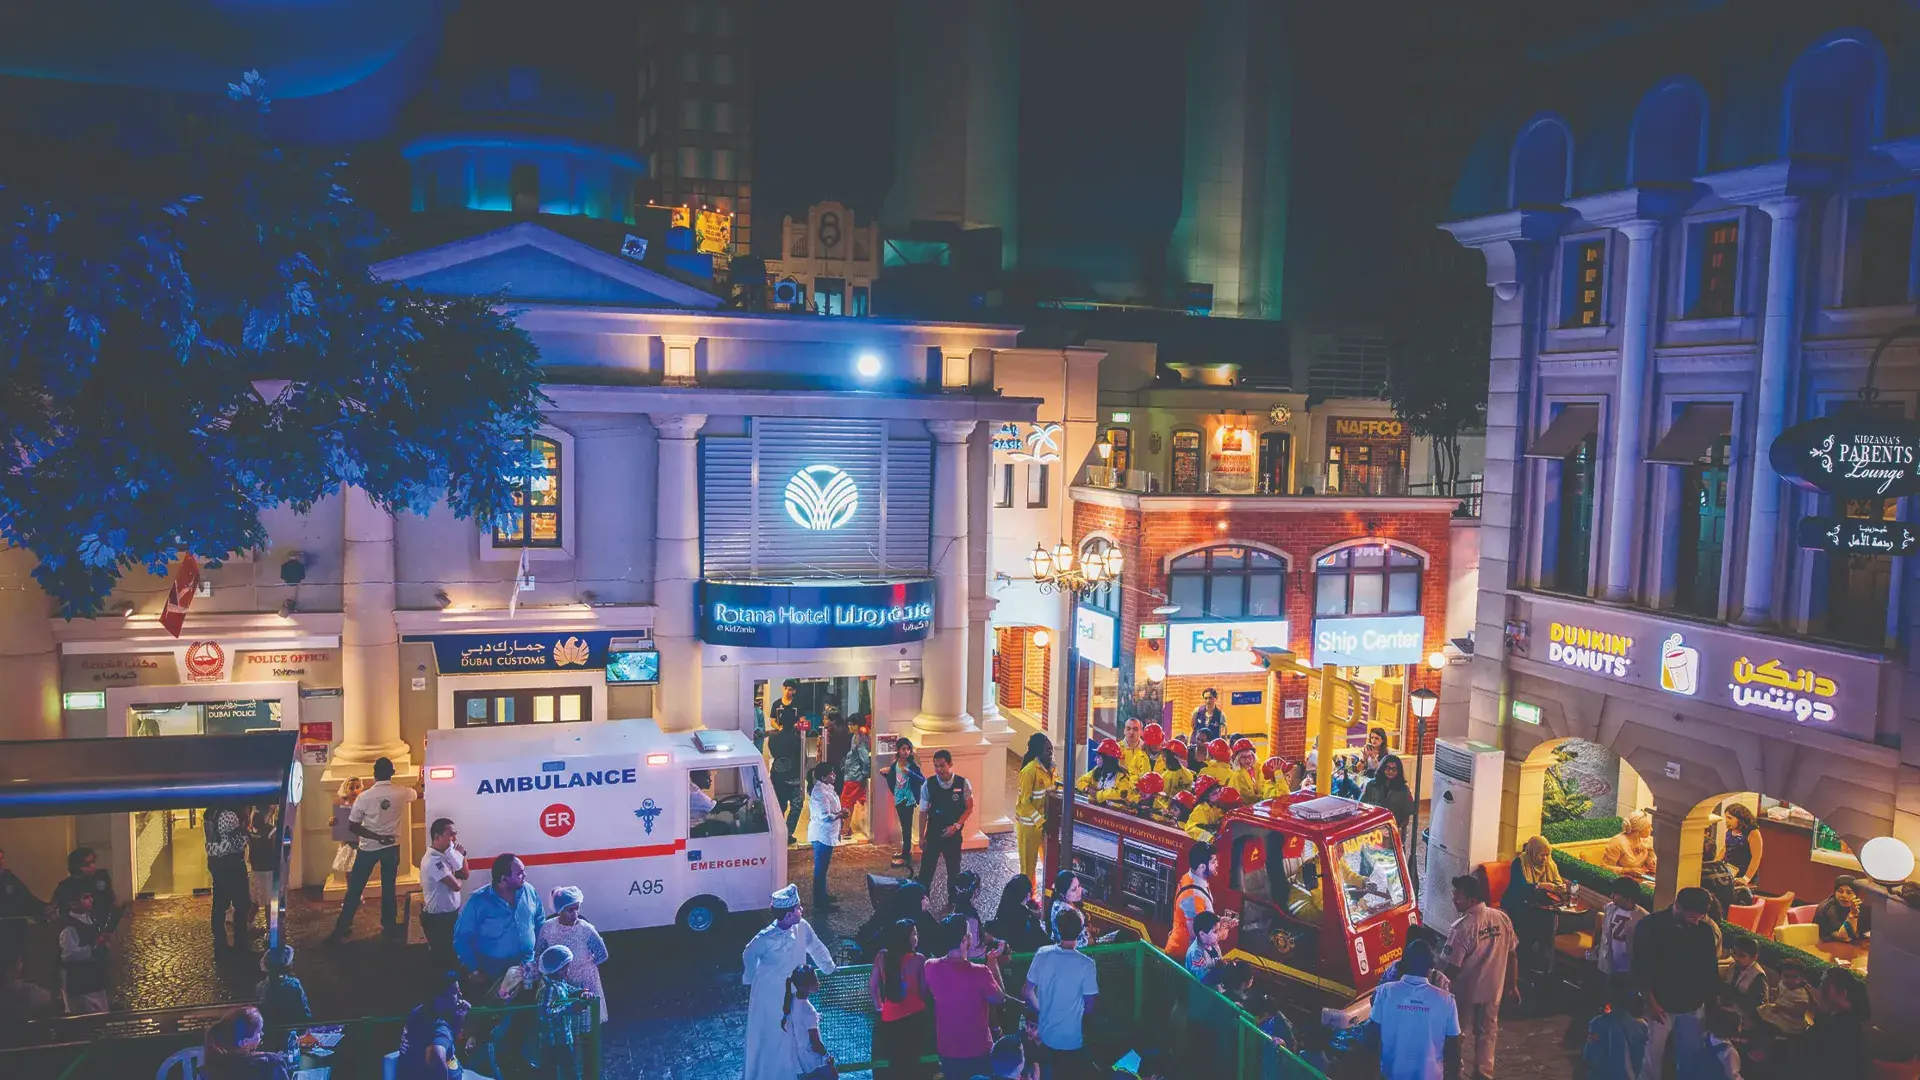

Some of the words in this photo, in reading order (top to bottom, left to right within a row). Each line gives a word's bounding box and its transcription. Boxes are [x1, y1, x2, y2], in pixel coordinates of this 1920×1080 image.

[1336, 419, 1402, 436] NAFFCO
[992, 438, 1023, 450] OASIS
[1854, 434, 1901, 445] KIDZANIA'S
[1838, 443, 1914, 464] PARENTS
[1844, 458, 1905, 494] Lounge
[714, 603, 776, 624] Rotana
[778, 606, 830, 624] Hotel
[836, 604, 887, 628] روتانا
[724, 625, 756, 633] KidZania
[492, 639, 546, 656] جمارك
[1191, 628, 1258, 653] FedEx
[1318, 630, 1358, 655] Ship
[1362, 629, 1421, 651] Center
[1549, 622, 1633, 656] DUNKIN'
[247, 655, 288, 664] POLICE
[290, 653, 330, 664] OFFICE
[461, 642, 491, 658] دبي
[1549, 641, 1628, 678] DONUTS
[461, 657, 492, 667] DUBAI
[496, 656, 546, 666] CUSTOMS
[1733, 656, 1837, 697] دانكن
[208, 710, 231, 718] DUBAI
[232, 709, 257, 718] POLICE
[476, 768, 637, 795] AMBULANCE
[544, 812, 571, 828] ER
[1129, 827, 1158, 840] FIGHTING
[1158, 836, 1185, 849] VEHICLE
[1342, 828, 1384, 853] NAFFCO
[690, 857, 767, 871] EMERGENCY
[628, 879, 664, 896] A95
[1379, 946, 1403, 965] NAFFCO
